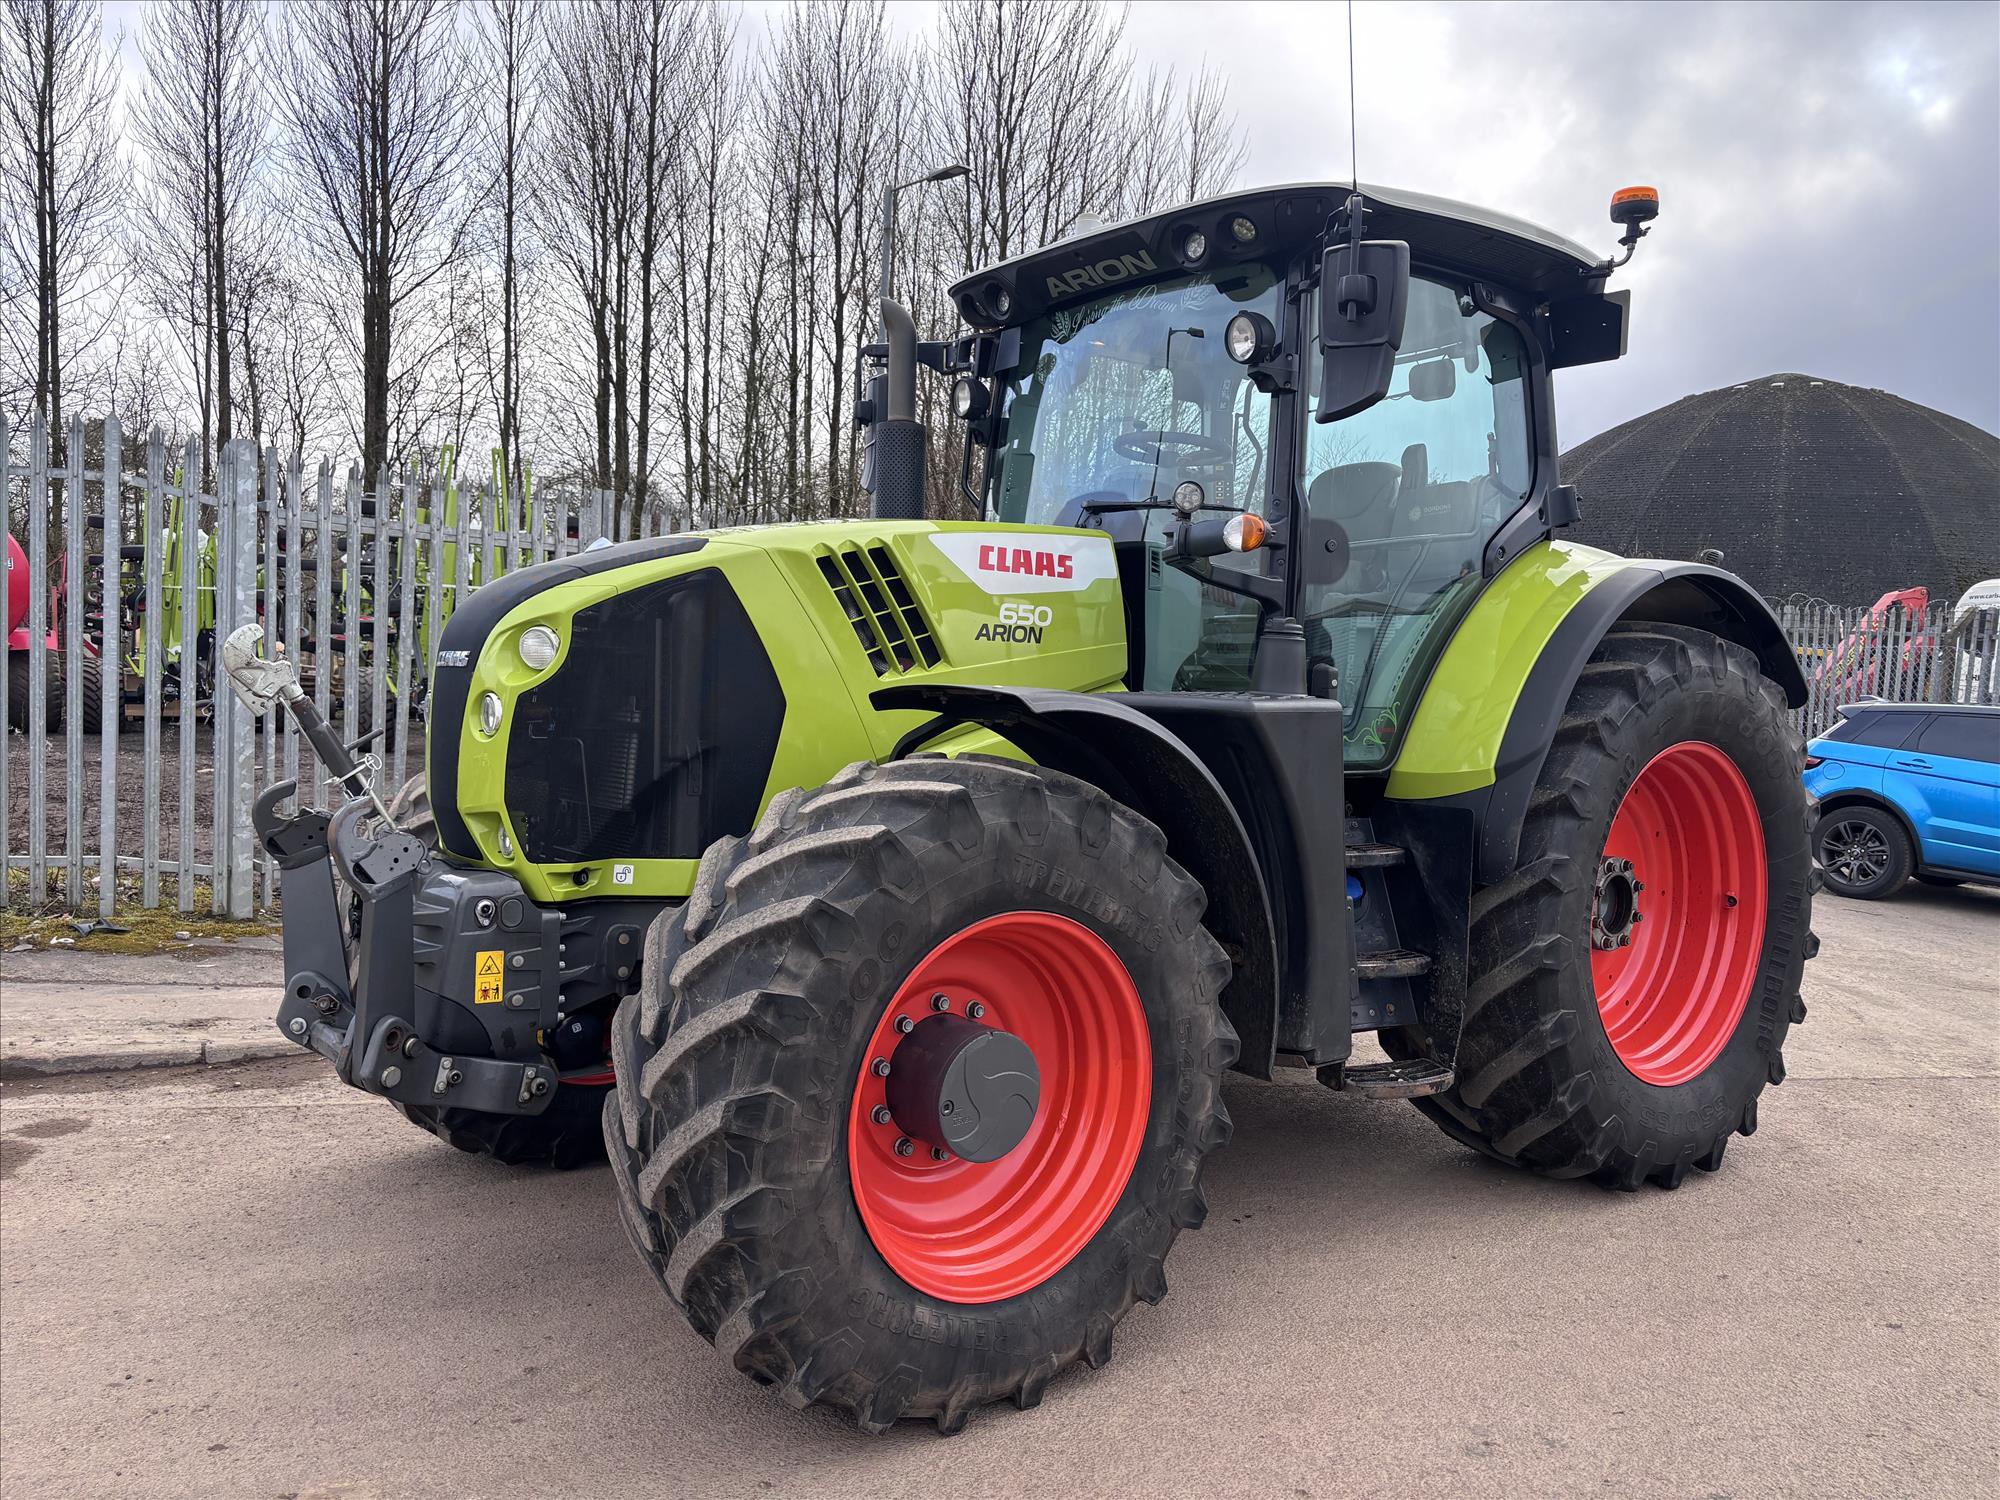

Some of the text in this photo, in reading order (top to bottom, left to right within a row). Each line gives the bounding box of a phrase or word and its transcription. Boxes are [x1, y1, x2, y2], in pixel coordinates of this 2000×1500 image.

[1046, 250, 1158, 297] ARION
[979, 545, 1074, 579] CLAAS
[1000, 603, 1053, 627] 650
[975, 624, 1043, 644] ARION
[1012, 854, 1164, 953] TRELLEBORG
